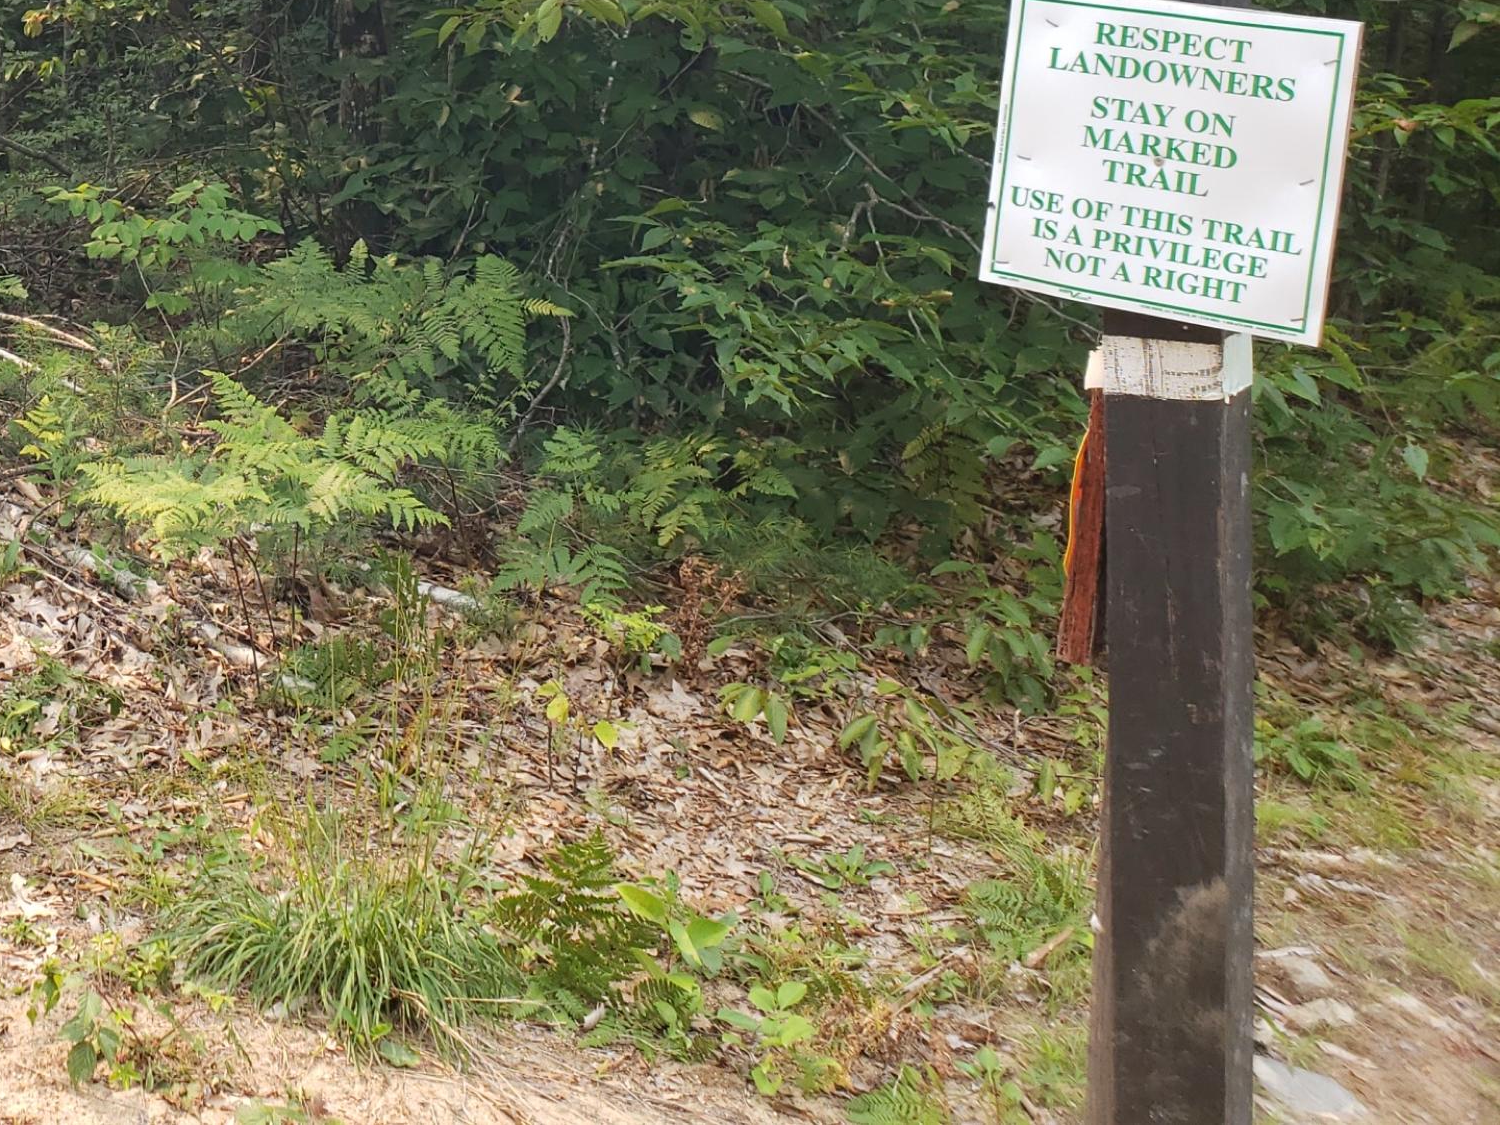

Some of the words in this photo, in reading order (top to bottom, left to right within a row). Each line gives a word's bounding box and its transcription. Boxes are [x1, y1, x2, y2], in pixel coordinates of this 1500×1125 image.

[1094, 22, 1252, 64] RESPECT
[1048, 47, 1296, 102] LANDOWNERS
[1090, 96, 1176, 128] STAY
[1184, 109, 1236, 138] ON
[1081, 125, 1238, 170] MARKED
[1102, 159, 1209, 197] TRAIL
[1010, 185, 1064, 214] USE
[1072, 198, 1113, 222] OF
[1120, 204, 1194, 237] THIS
[1202, 218, 1302, 256] TRAIL
[1031, 217, 1058, 241] IS
[1064, 224, 1084, 247] A
[1093, 228, 1268, 279] PRIVILEGE
[1043, 247, 1107, 277] NOT
[1110, 262, 1132, 284] A
[1142, 266, 1247, 303] RIGHT
